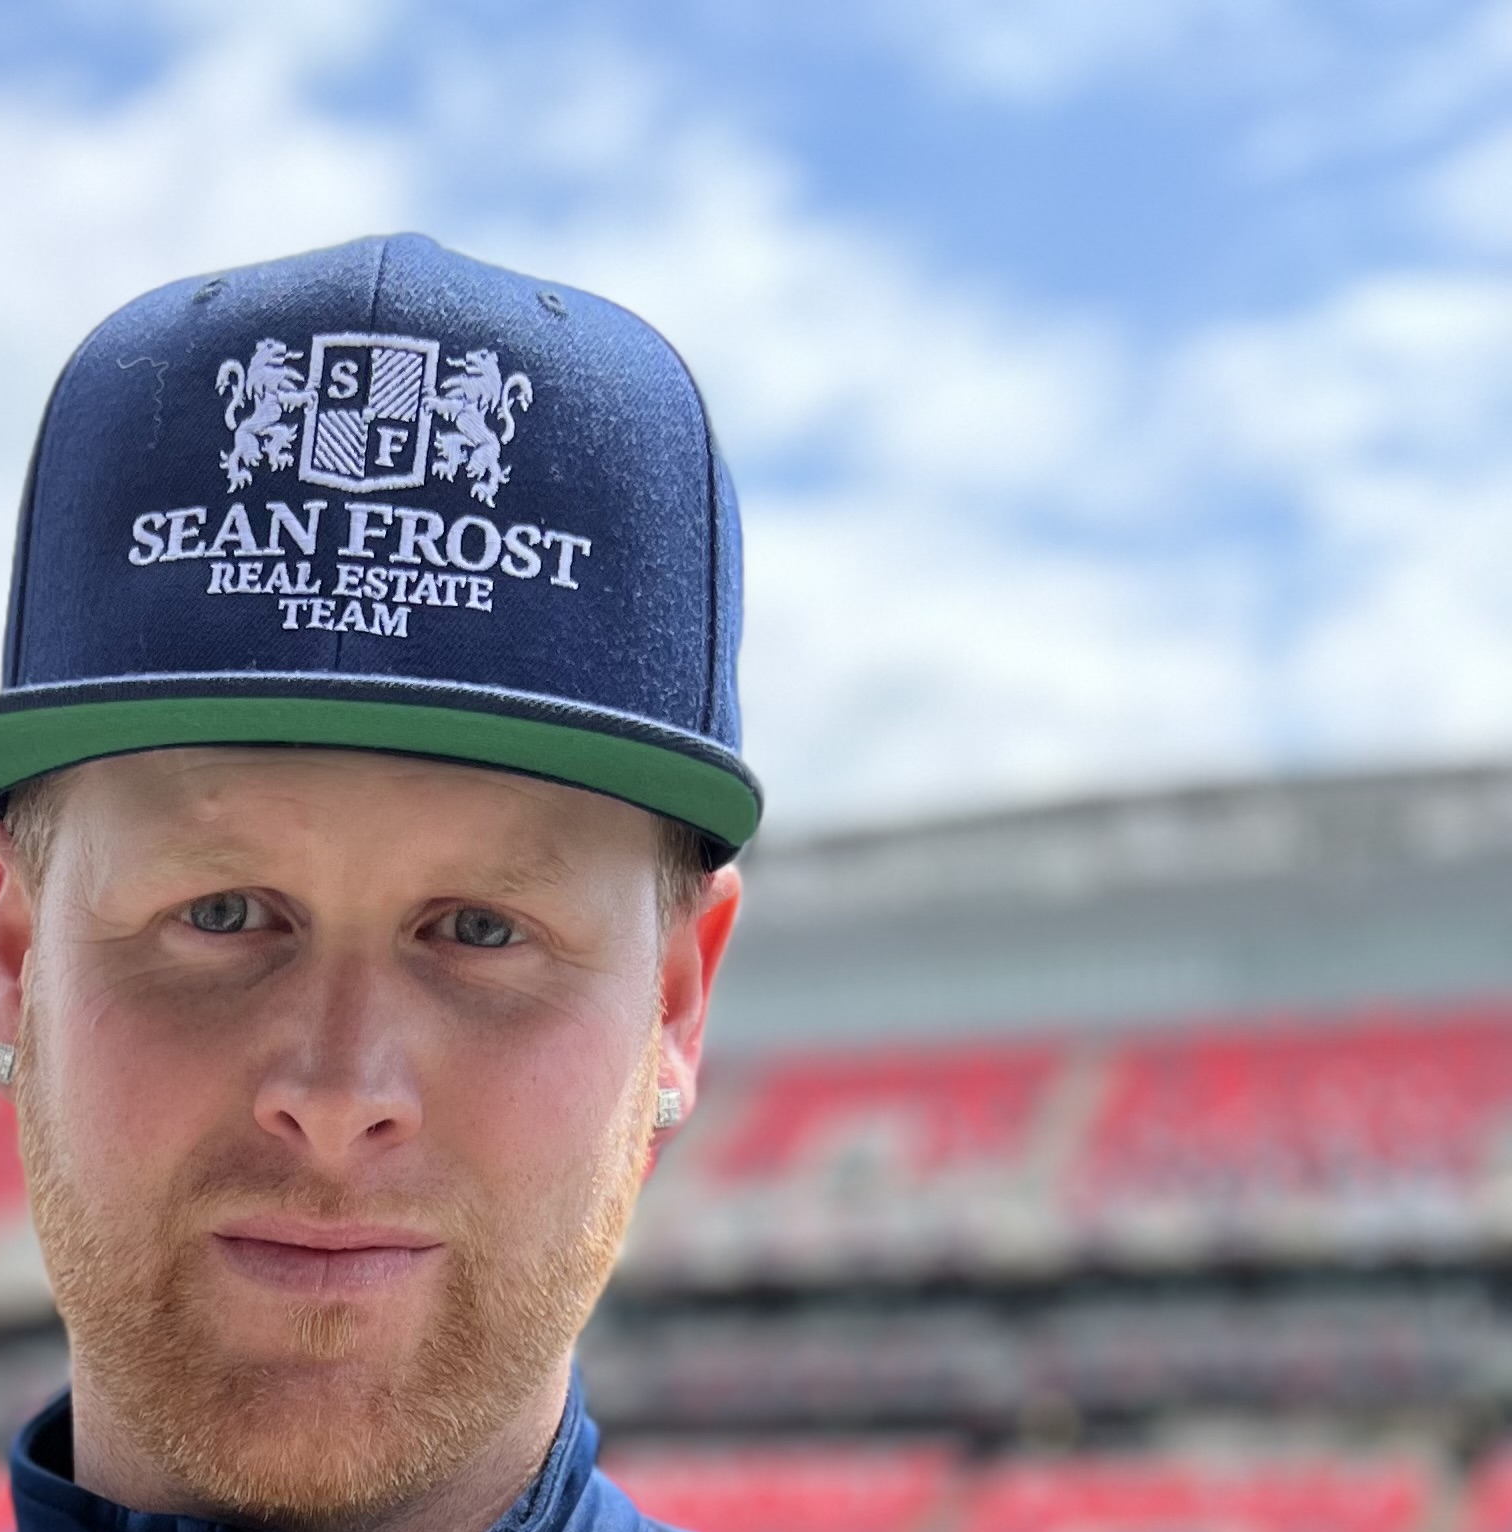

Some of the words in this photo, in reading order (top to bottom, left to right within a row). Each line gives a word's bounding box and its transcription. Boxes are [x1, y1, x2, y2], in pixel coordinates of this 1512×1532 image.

[328, 360, 360, 399] S
[375, 427, 409, 467] F
[128, 500, 327, 566] SEAN
[337, 502, 591, 589] FROST
[207, 562, 322, 595] REAL
[332, 563, 494, 612] ESTATE
[278, 598, 412, 638] TEAM
